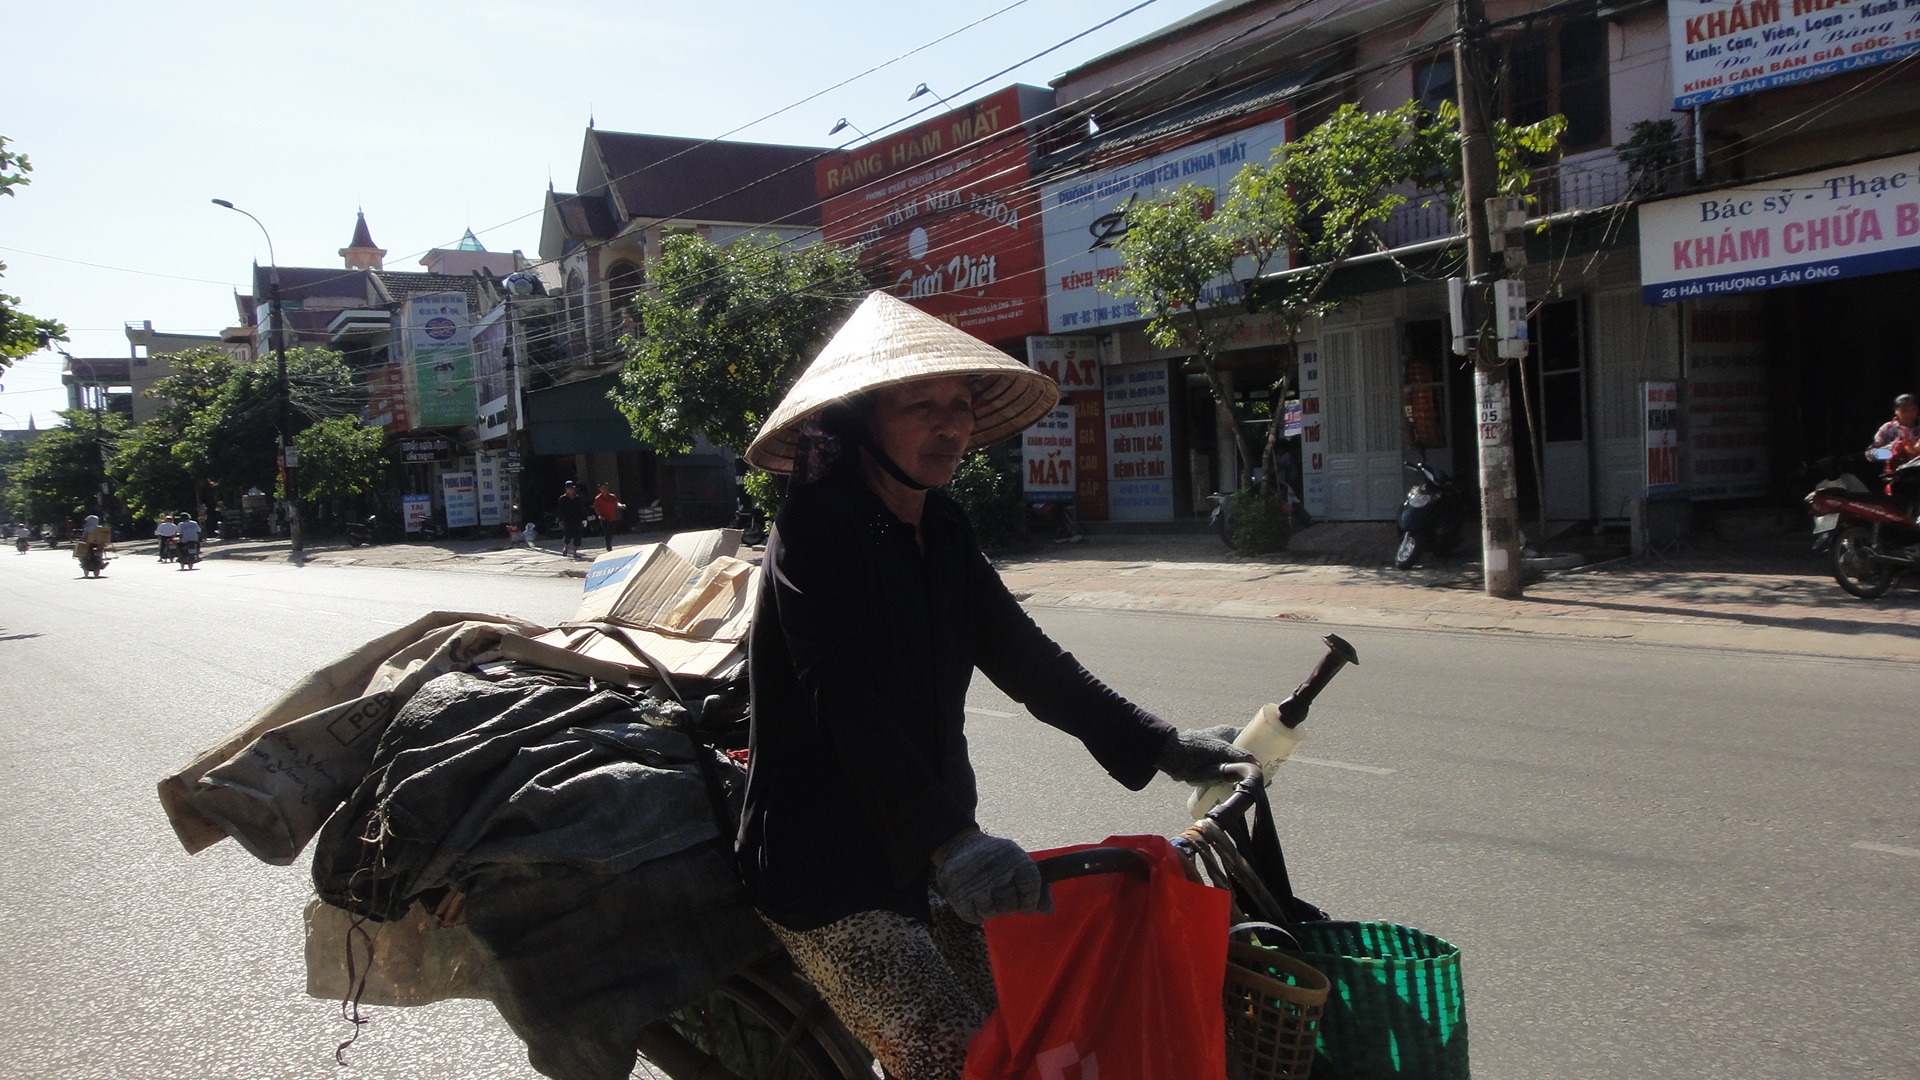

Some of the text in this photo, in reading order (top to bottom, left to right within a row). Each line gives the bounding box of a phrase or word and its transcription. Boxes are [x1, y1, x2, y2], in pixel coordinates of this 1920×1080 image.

[1711, 84, 1736, 100] 26
[1700, 198, 1754, 223] Bác
[1824, 171, 1908, 201] Thạc
[1673, 226, 1771, 271] KHÁM
[1782, 204, 1883, 255] CHỮA
[1662, 287, 1678, 299] 26
[1680, 281, 1704, 296] HẢI
[1706, 275, 1767, 293] THƯỢNG
[1805, 264, 1840, 280] ÔNG
[1481, 410, 1498, 422] 05
[1028, 449, 1072, 485] MẮT
